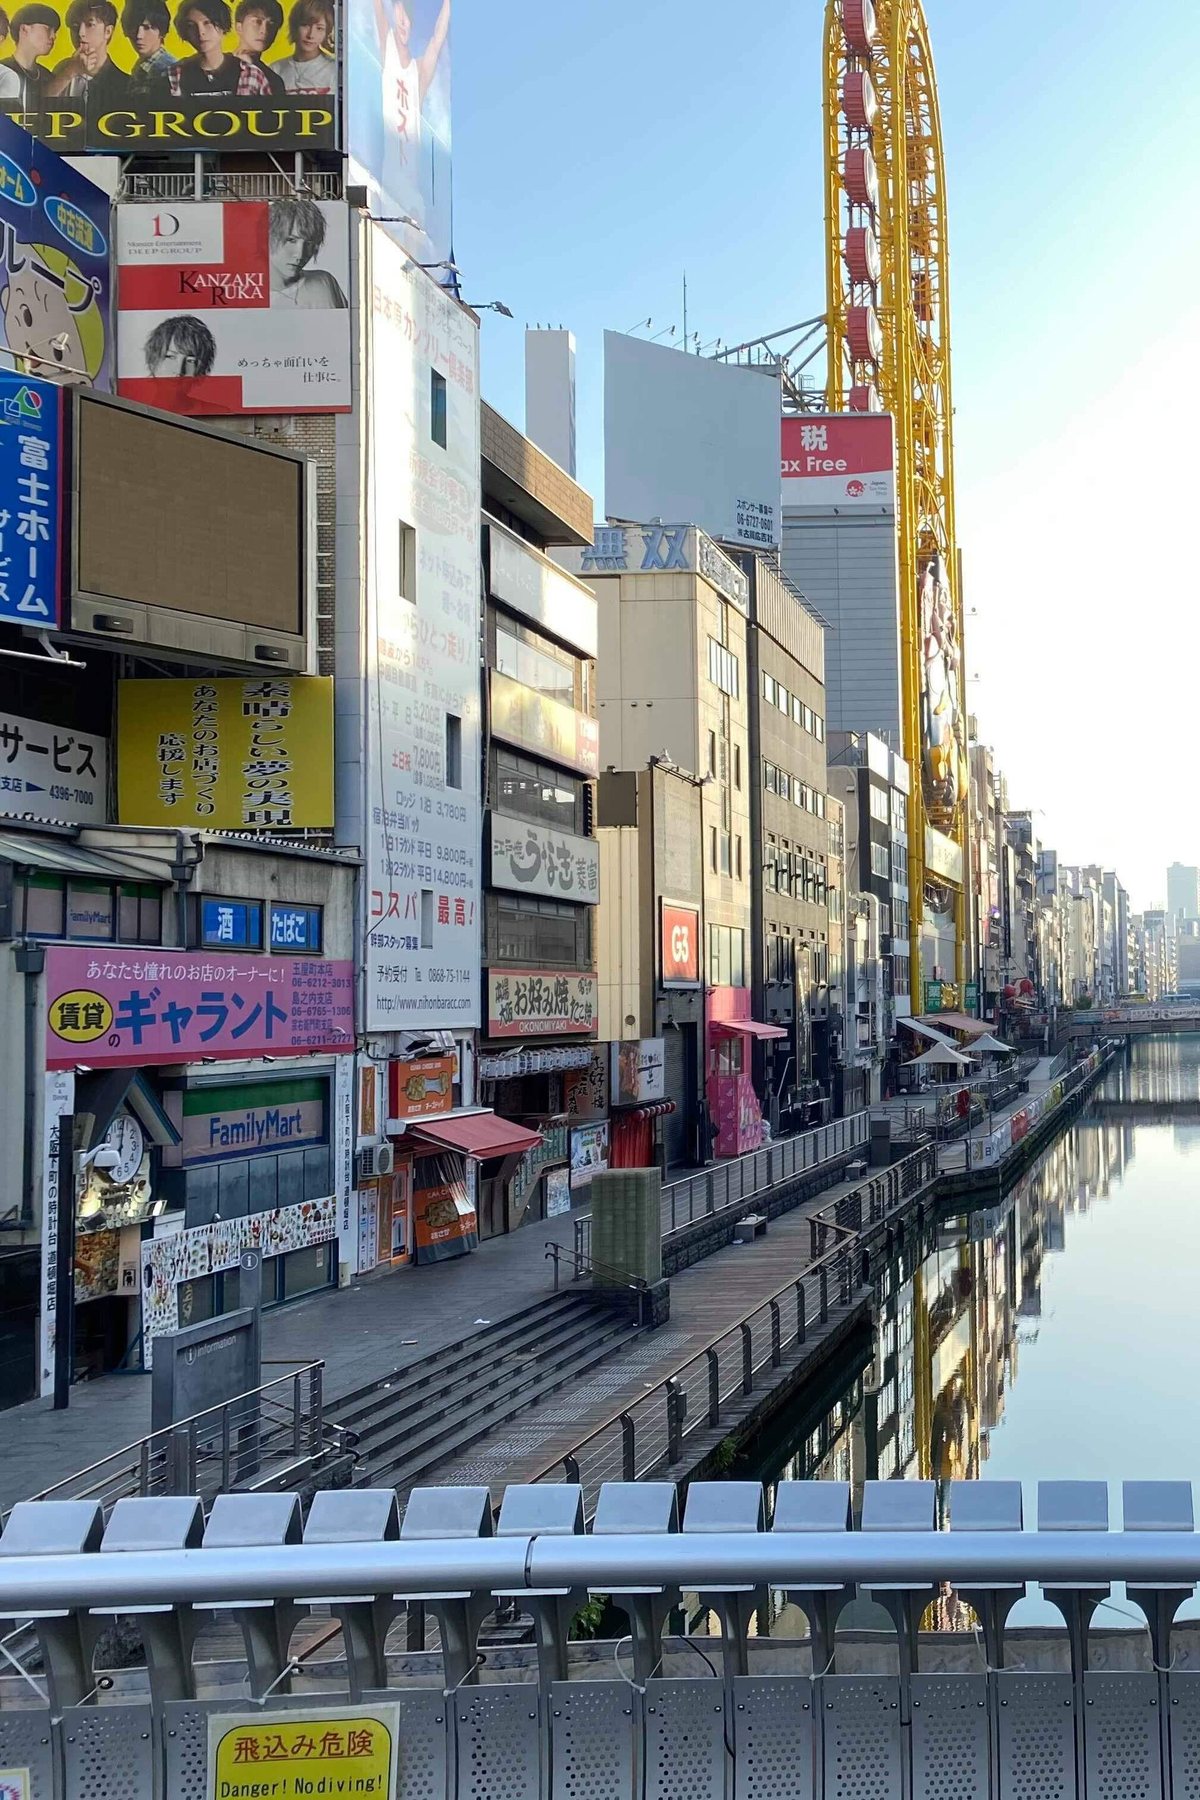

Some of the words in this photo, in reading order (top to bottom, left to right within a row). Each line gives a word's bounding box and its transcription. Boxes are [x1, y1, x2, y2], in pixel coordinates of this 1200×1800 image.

[97, 109, 333, 138] GROUP
[178, 271, 264, 293] KANZAKI
[211, 286, 264, 305] RUKA
[237, 355, 330, 369] めっちゃ面白いを
[303, 371, 343, 383] 仕事に。
[801, 424, 828, 452] 税
[781, 459, 801, 473] ax
[806, 456, 847, 473] Free
[736, 499, 773, 515] スポンサー募集中
[16, 434, 50, 617] 富士ホーム
[580, 526, 690, 571] 無双
[0, 723, 97, 779] サービス
[192, 684, 219, 815] あなたのお店づくり
[242, 681, 294, 826] 素晴らしい夢の実現
[158, 732, 187, 806] 応援します
[1, 777, 22, 794] 支店
[50, 786, 94, 806] 4396-7000
[396, 790, 416, 809] ロッジ
[436, 801, 468, 824] 3,780円
[417, 841, 433, 860] 平日
[436, 845, 467, 867] 9,800円
[510, 828, 574, 892] うなぎ
[417, 866, 433, 882] 平日
[371, 889, 418, 921] コスパ
[217, 907, 235, 941] 酒
[271, 914, 306, 944] たばこ
[370, 931, 420, 951] 幹部スタッフ募集
[671, 924, 690, 963] G3
[86, 960, 286, 983] あなたも憧れのお店のオーナーに!
[291, 977, 351, 989] 06-6212-3013
[376, 964, 408, 984] 予約受付
[292, 991, 333, 1006] 島之内支店
[513, 975, 570, 1017] お好み焼
[57, 1001, 105, 1031] 賃貸
[114, 987, 288, 1046] ギャラント
[519, 1019, 568, 1034] OKONOMIYAKI
[108, 1033, 121, 1048] の
[209, 1109, 303, 1148] FamilyMart
[197, 1335, 237, 1357] information
[233, 1729, 374, 1761] 飛込み危険
[221, 1778, 286, 1799] Danger!
